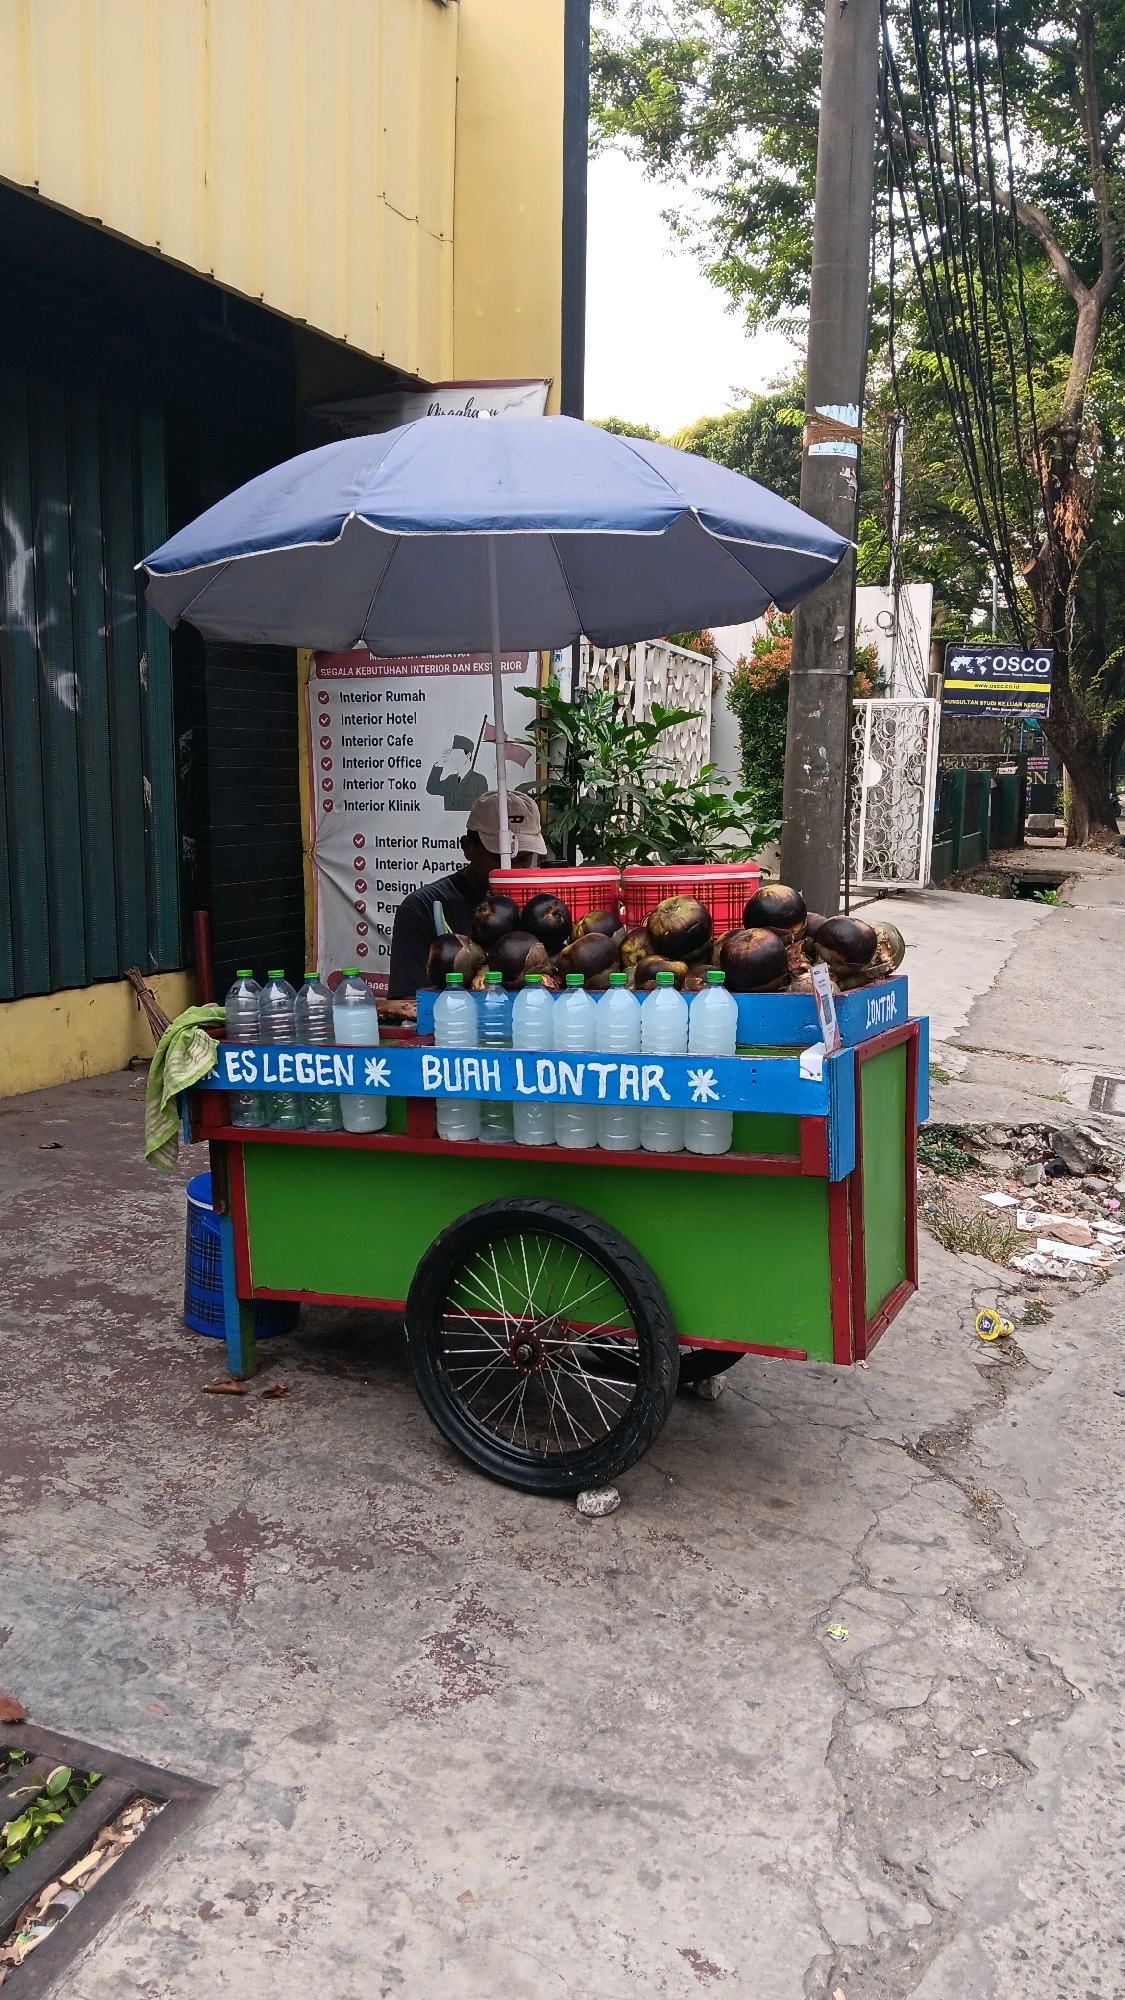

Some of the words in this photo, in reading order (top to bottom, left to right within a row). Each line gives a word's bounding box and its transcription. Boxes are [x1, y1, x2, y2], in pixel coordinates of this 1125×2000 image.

[320, 667, 354, 676] SEGALA
[355, 665, 408, 676] KEBUTUHAN
[410, 663, 450, 674] INTERIOR
[452, 663, 471, 672] DAN
[473, 661, 522, 672] EKSTRIOR
[992, 656, 1051, 673] OSCO
[340, 691, 383, 703] Interior
[386, 690, 426, 702] Rumah
[341, 713, 383, 725] Interior
[386, 712, 417, 725] Hotel
[341, 735, 383, 747] Interior
[386, 734, 414, 746] Cafe
[342, 757, 384, 769] Interior
[387, 756, 422, 768] Office
[343, 778, 384, 790] Interior
[389, 778, 417, 790] Toko
[344, 799, 386, 811] Interior
[388, 800, 421, 812] Klinik
[375, 835, 418, 848] Interior
[375, 857, 418, 871] Interior
[376, 879, 417, 895] Design
[865, 990, 898, 1030] LONTAR
[225, 1050, 258, 1084] ES
[263, 1052, 354, 1087] LEGEN
[422, 1054, 502, 1092] BUAH
[515, 1058, 671, 1102] LONTAR
